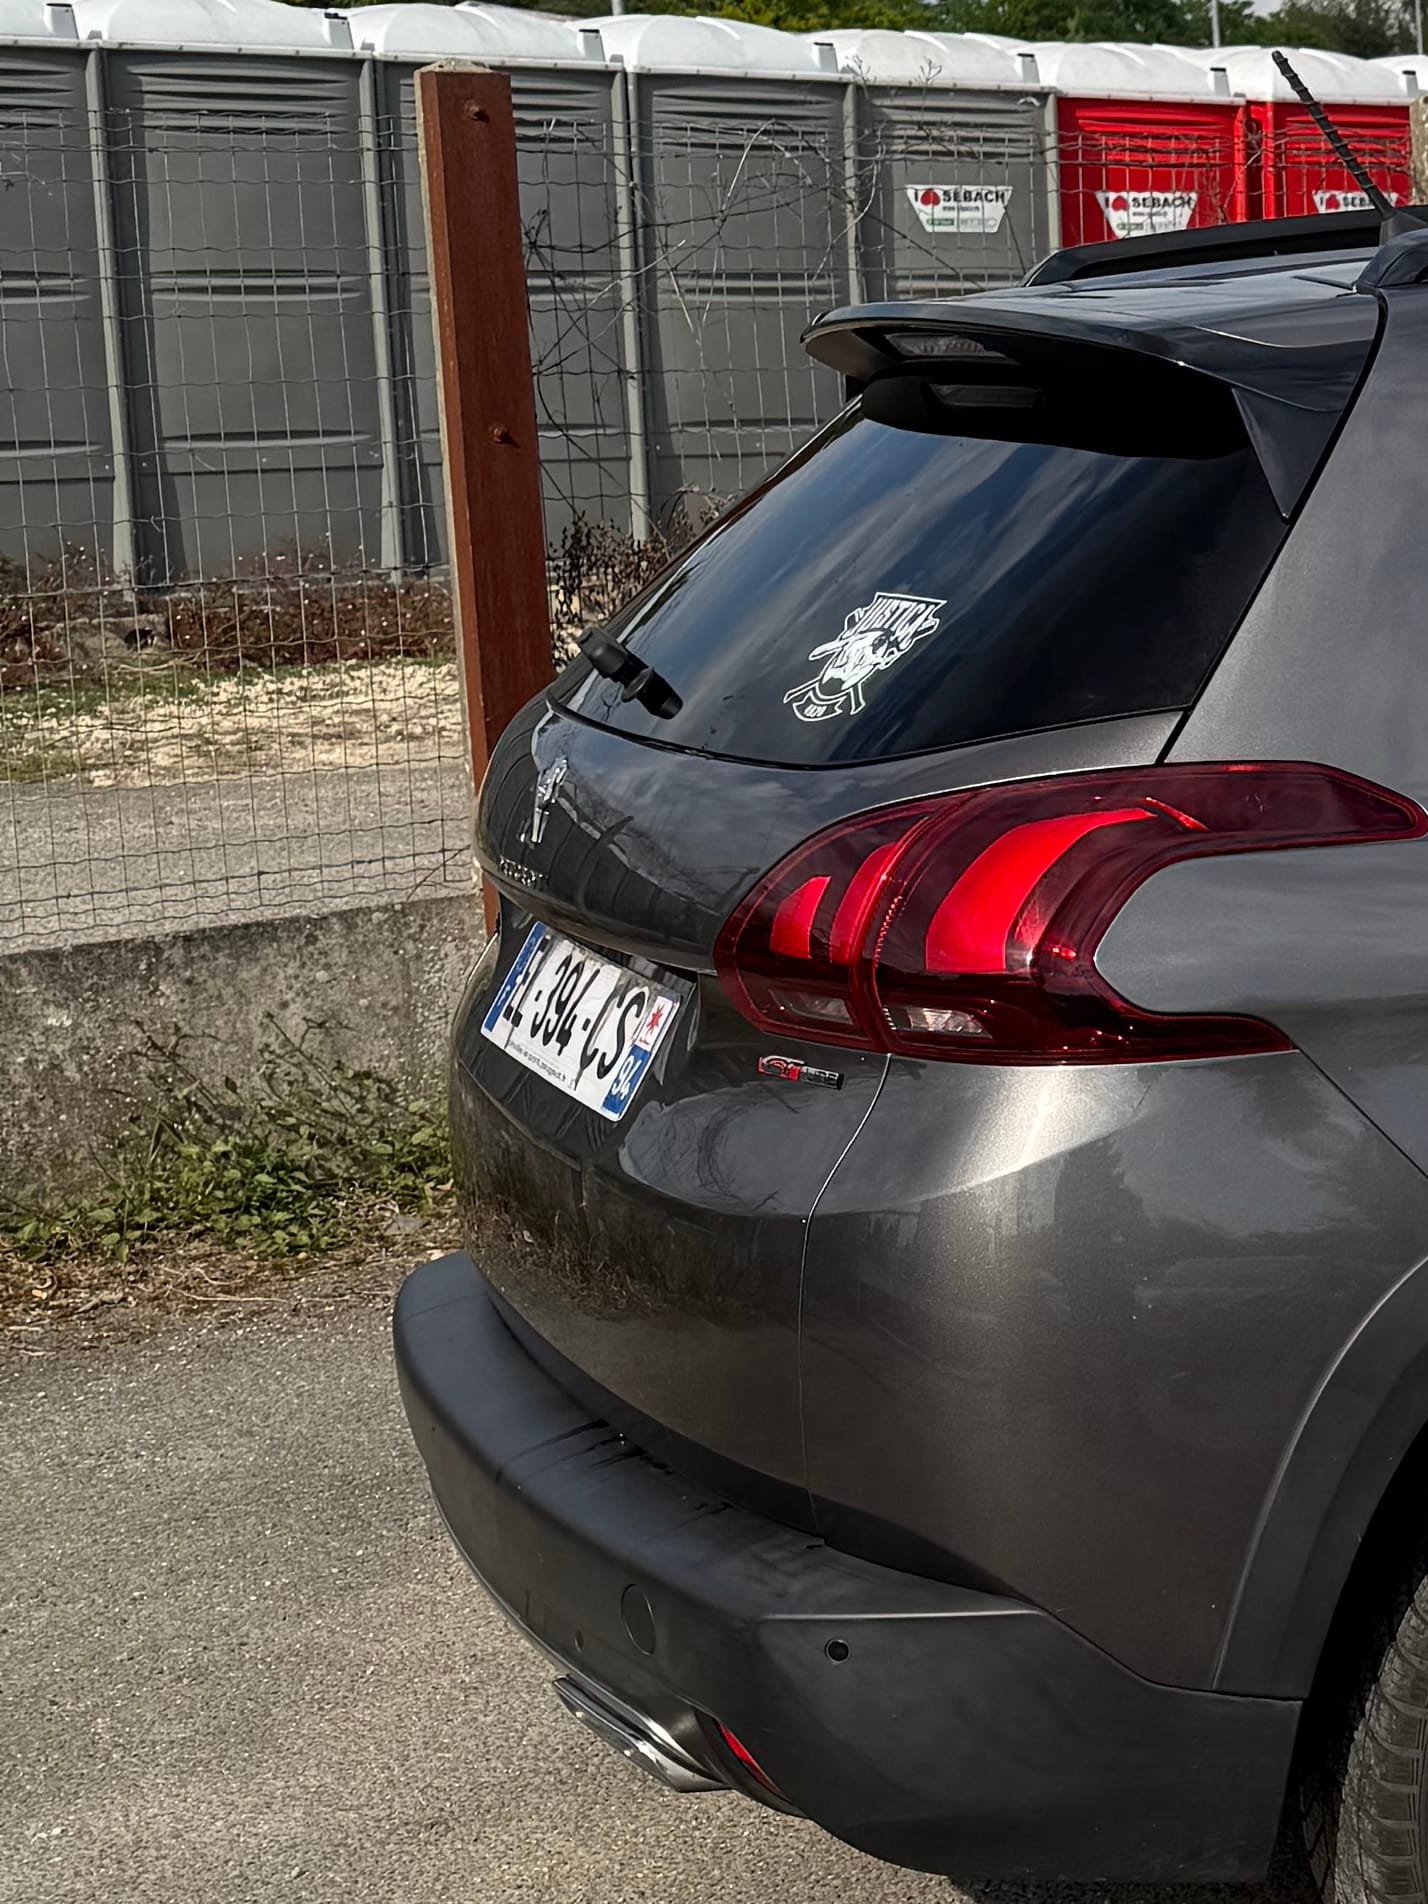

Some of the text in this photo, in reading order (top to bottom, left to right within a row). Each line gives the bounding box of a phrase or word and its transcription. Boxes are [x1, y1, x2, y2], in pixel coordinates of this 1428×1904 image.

[942, 190, 1005, 204] SEBACH
[1131, 197, 1192, 209] SEBACH
[503, 937, 646, 1080] EL-394-CS
[611, 1055, 642, 1101] 94
